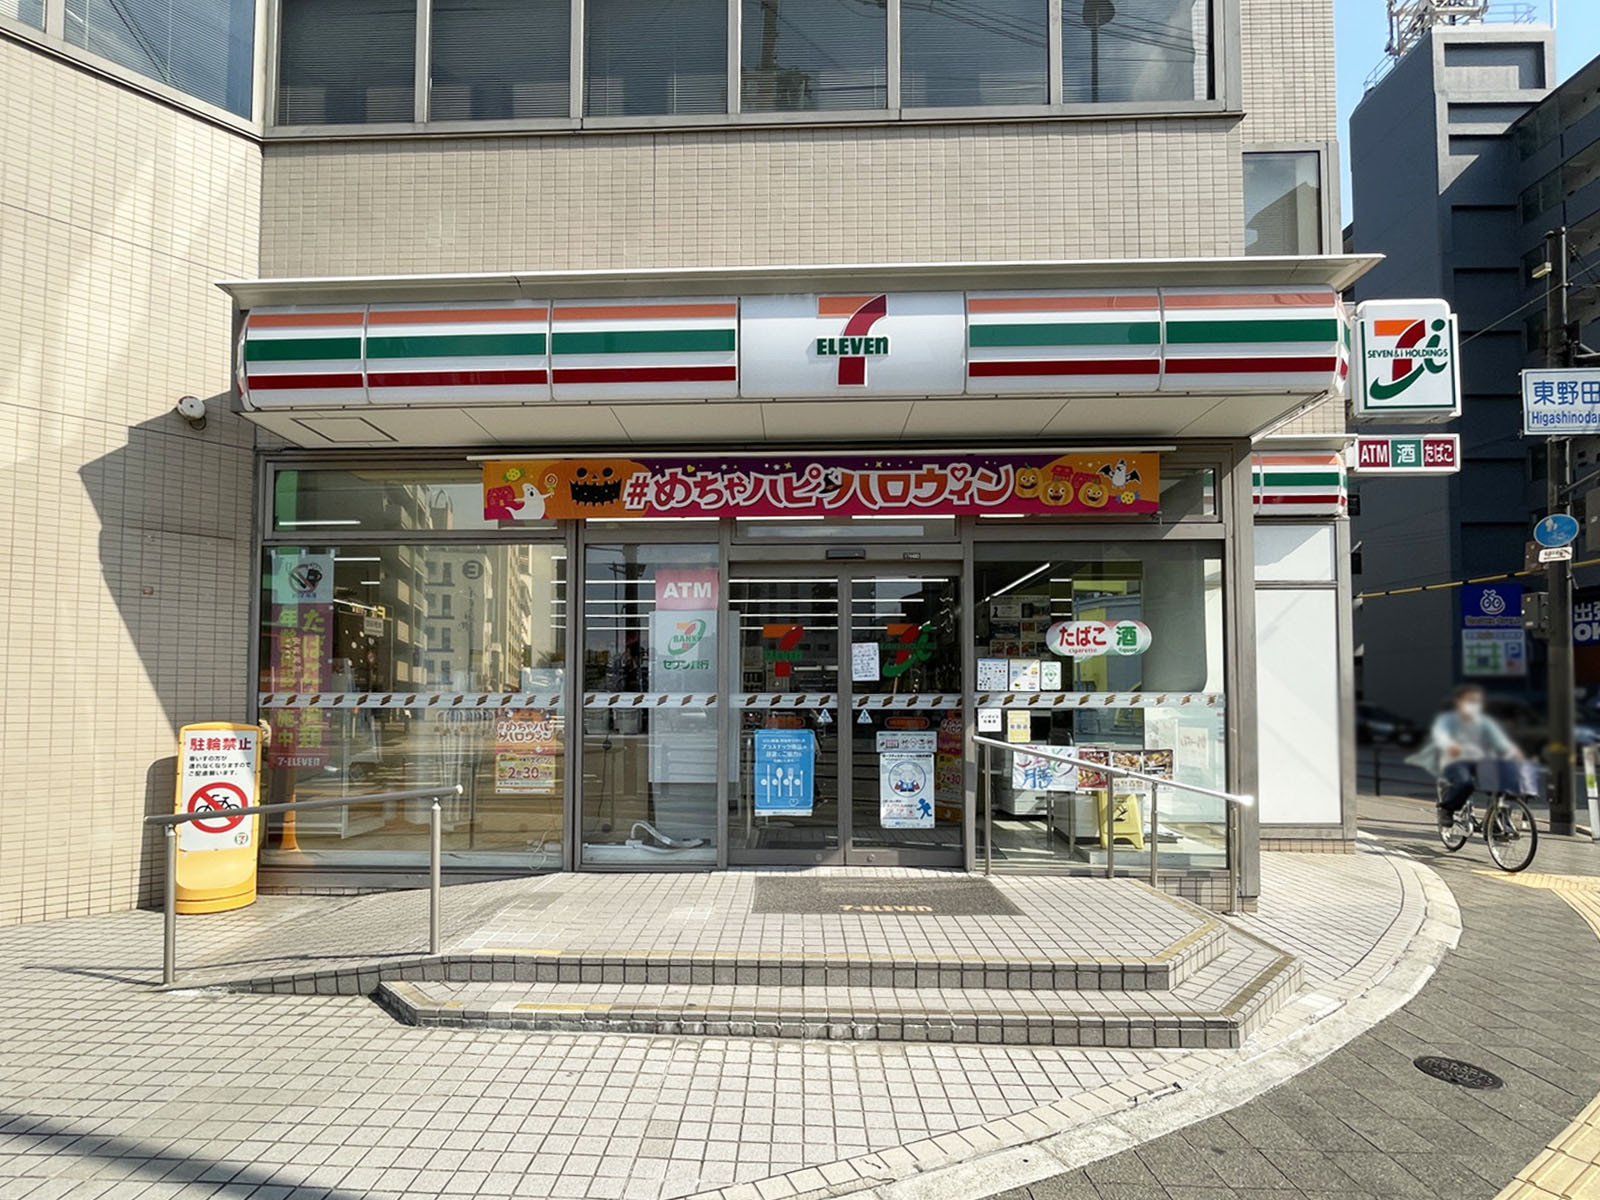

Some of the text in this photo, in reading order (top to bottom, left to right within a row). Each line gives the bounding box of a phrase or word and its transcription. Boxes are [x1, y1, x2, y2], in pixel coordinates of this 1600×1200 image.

[1405, 348, 1449, 358] HOLDINGS
[1533, 381, 1600, 405] 東野田
[1532, 411, 1600, 426] Higashinoda
[1361, 444, 1388, 463] ATM
[1397, 444, 1416, 463] 酒
[1424, 443, 1454, 462] たばこ
[663, 582, 712, 598] ATM
[1059, 626, 1107, 646] たばこ
[1116, 626, 1137, 646] 酒
[190, 737, 252, 751] 駐輪禁止
